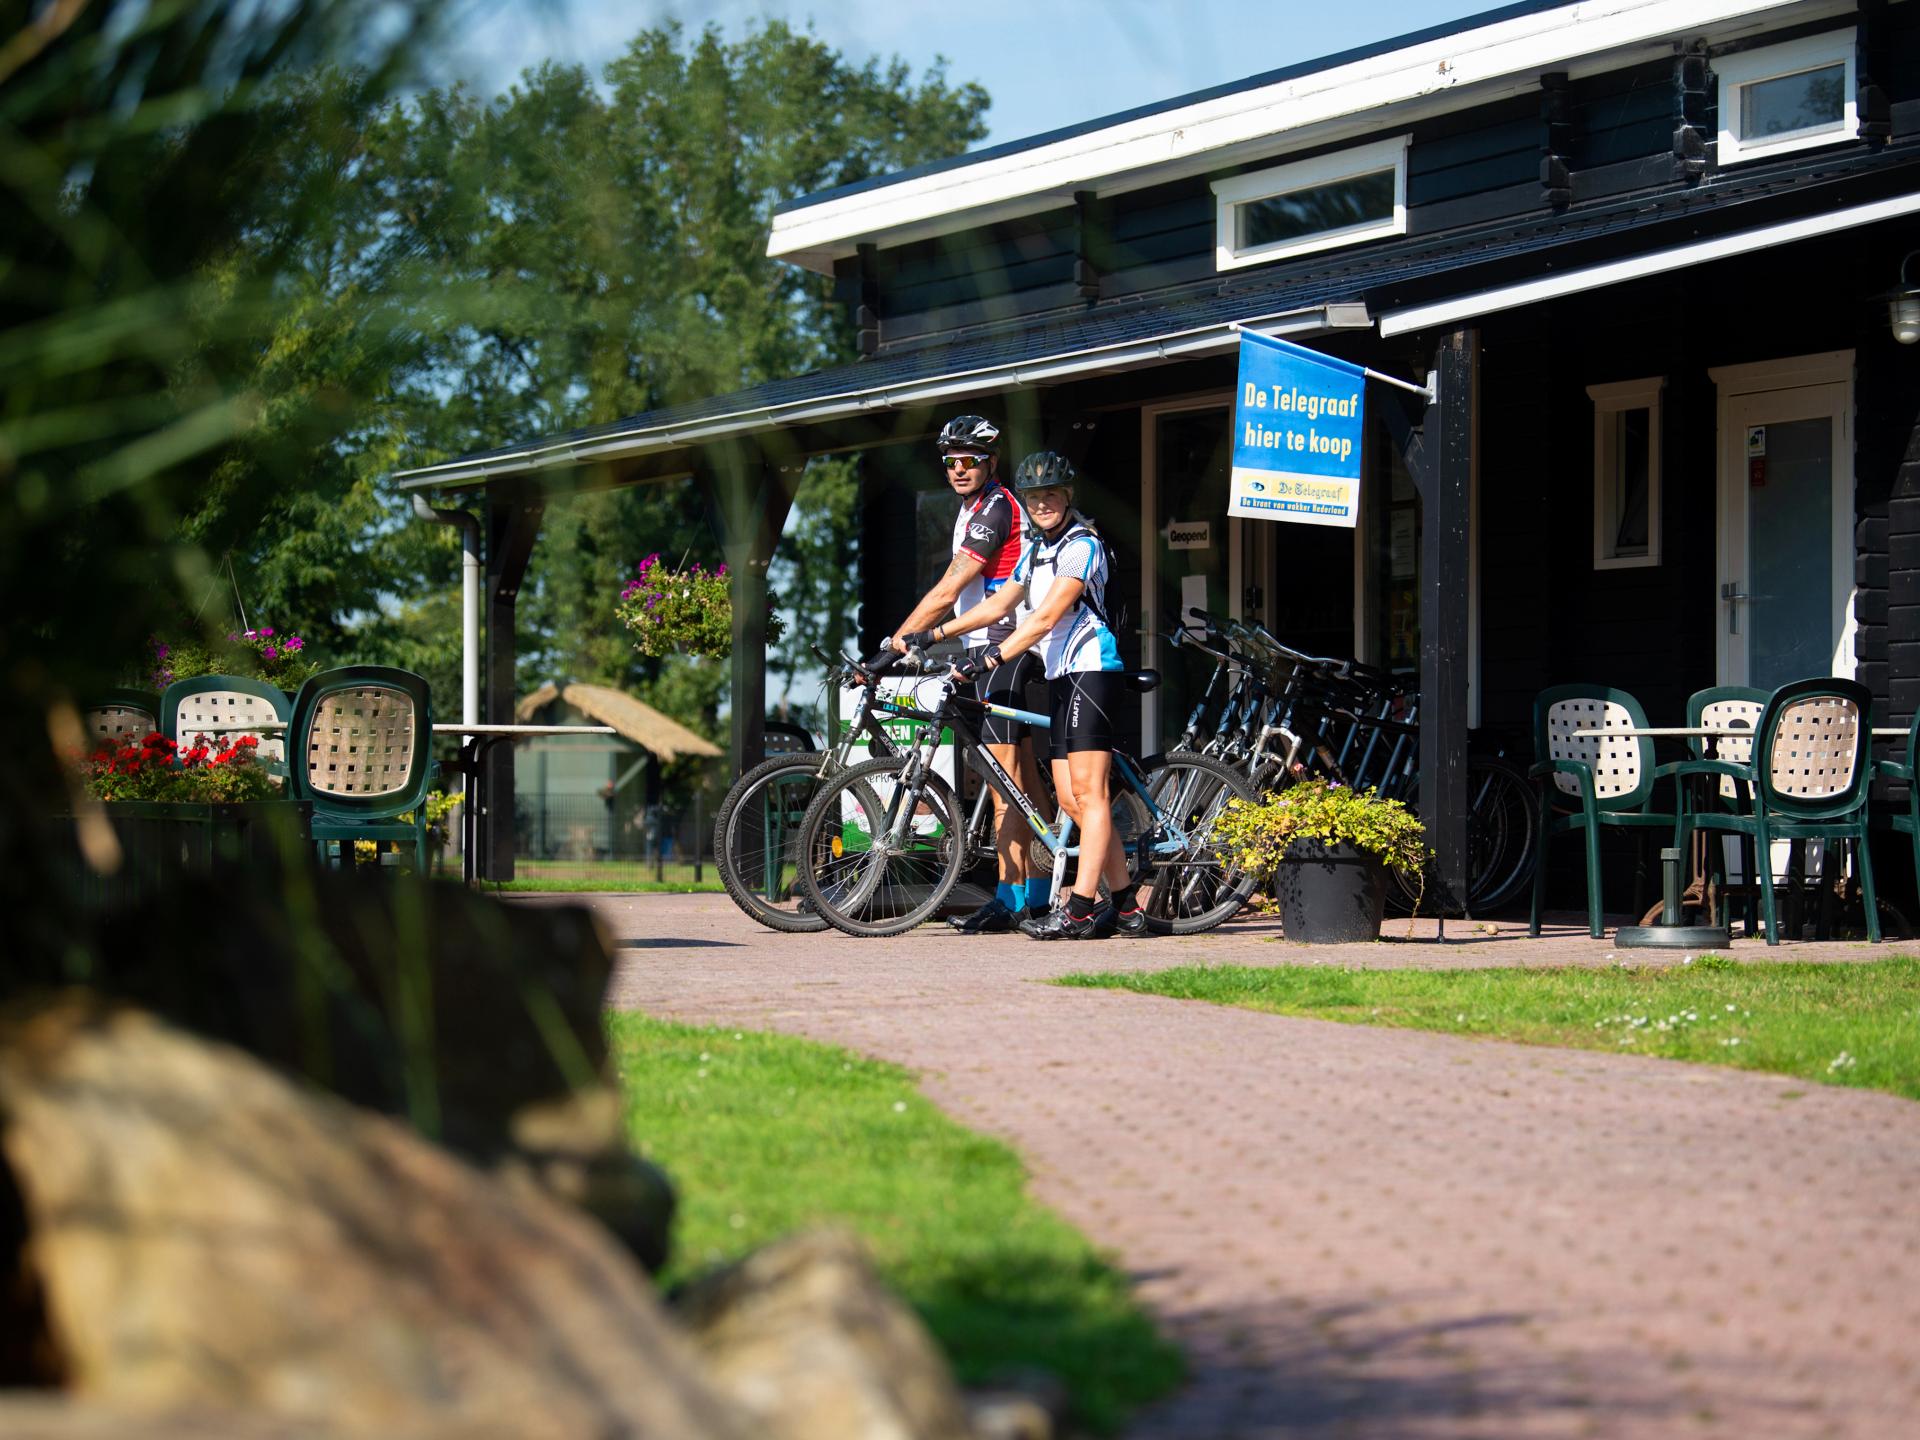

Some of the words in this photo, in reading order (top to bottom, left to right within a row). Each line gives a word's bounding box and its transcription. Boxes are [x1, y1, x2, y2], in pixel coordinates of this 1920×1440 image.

[1245, 382, 1267, 408] De
[1272, 384, 1358, 420] Telegraaf
[1244, 421, 1282, 449] hier
[1286, 429, 1305, 451] te
[1309, 427, 1352, 462] koop
[1278, 481, 1292, 494] De
[1295, 482, 1343, 501] Telegraaf
[1252, 498, 1271, 509] krant
[1273, 501, 1285, 510] van
[1287, 502, 1310, 512] wakker
[1312, 504, 1346, 515] Nederland
[1170, 529, 1208, 544] Geopend
